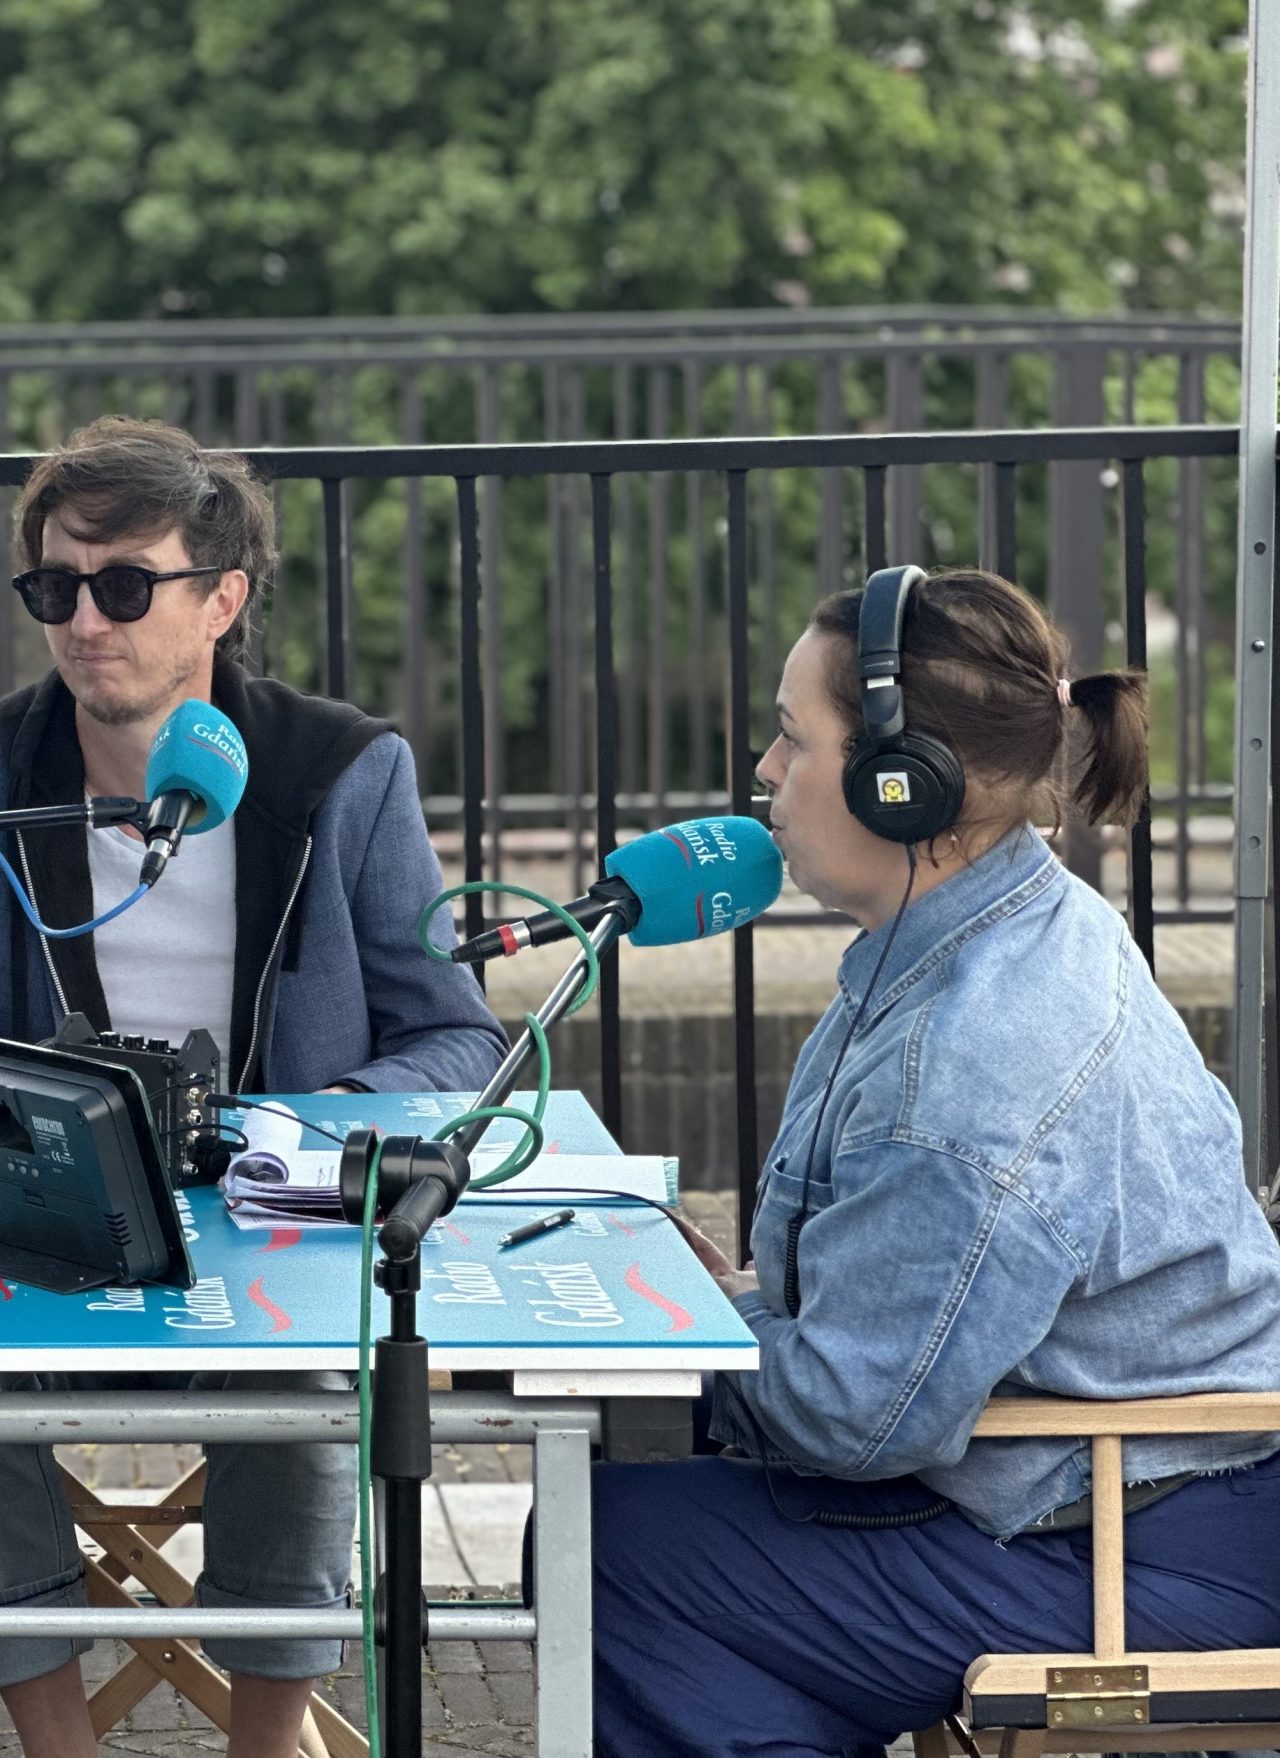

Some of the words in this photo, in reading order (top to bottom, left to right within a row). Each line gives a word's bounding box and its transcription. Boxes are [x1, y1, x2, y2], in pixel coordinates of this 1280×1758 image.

[678, 822, 719, 866] dańsk
[705, 822, 737, 861] Radio
[421, 1261, 507, 1306] Radio
[508, 1260, 625, 1328] Gdańsk
